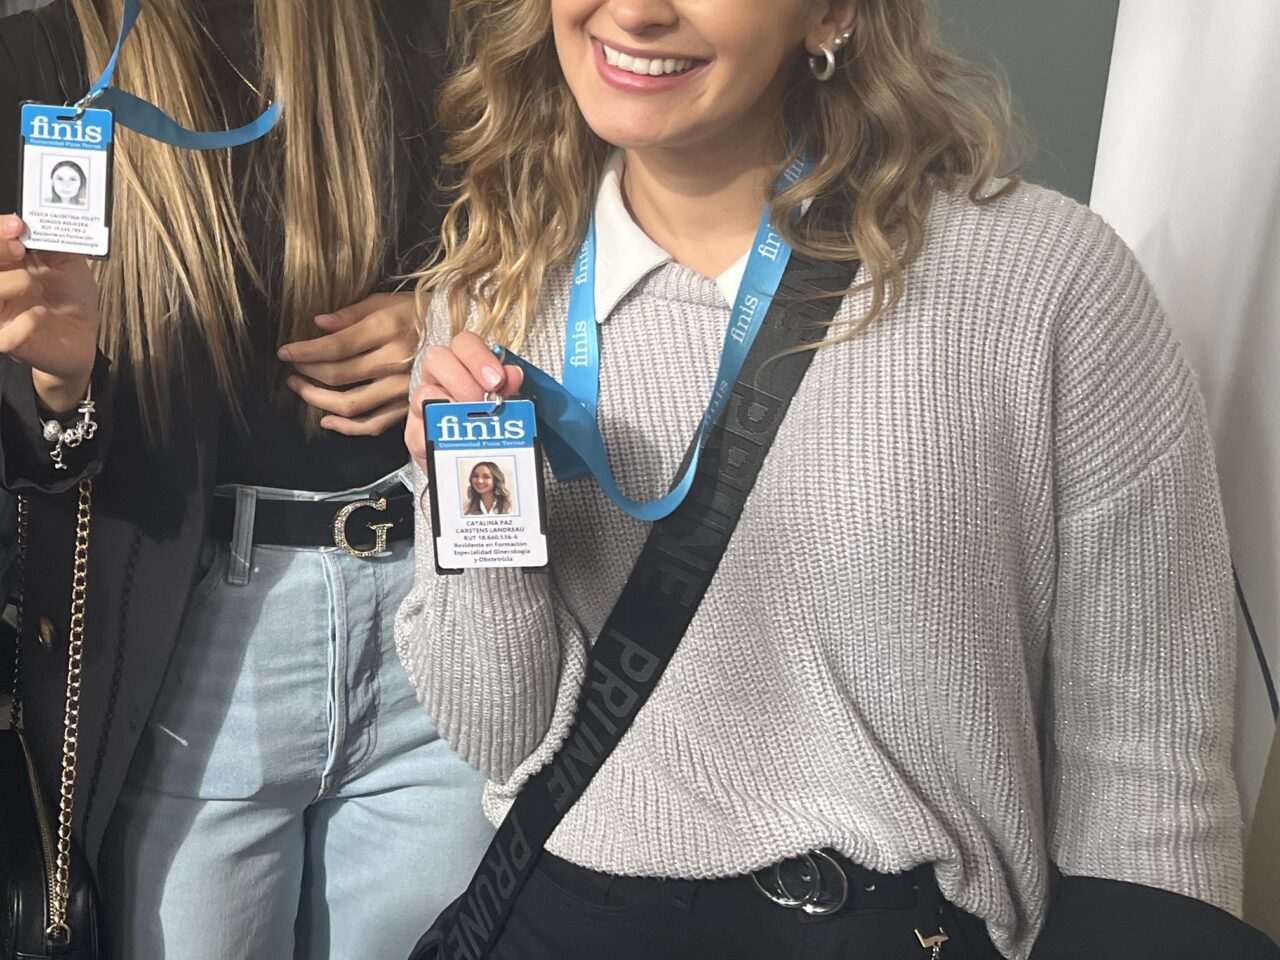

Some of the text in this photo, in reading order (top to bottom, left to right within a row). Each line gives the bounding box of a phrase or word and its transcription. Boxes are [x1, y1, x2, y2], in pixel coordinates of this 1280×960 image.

[30, 115, 102, 143] finis
[730, 294, 759, 345] finis
[570, 320, 588, 368] finis
[436, 415, 525, 441] finis
